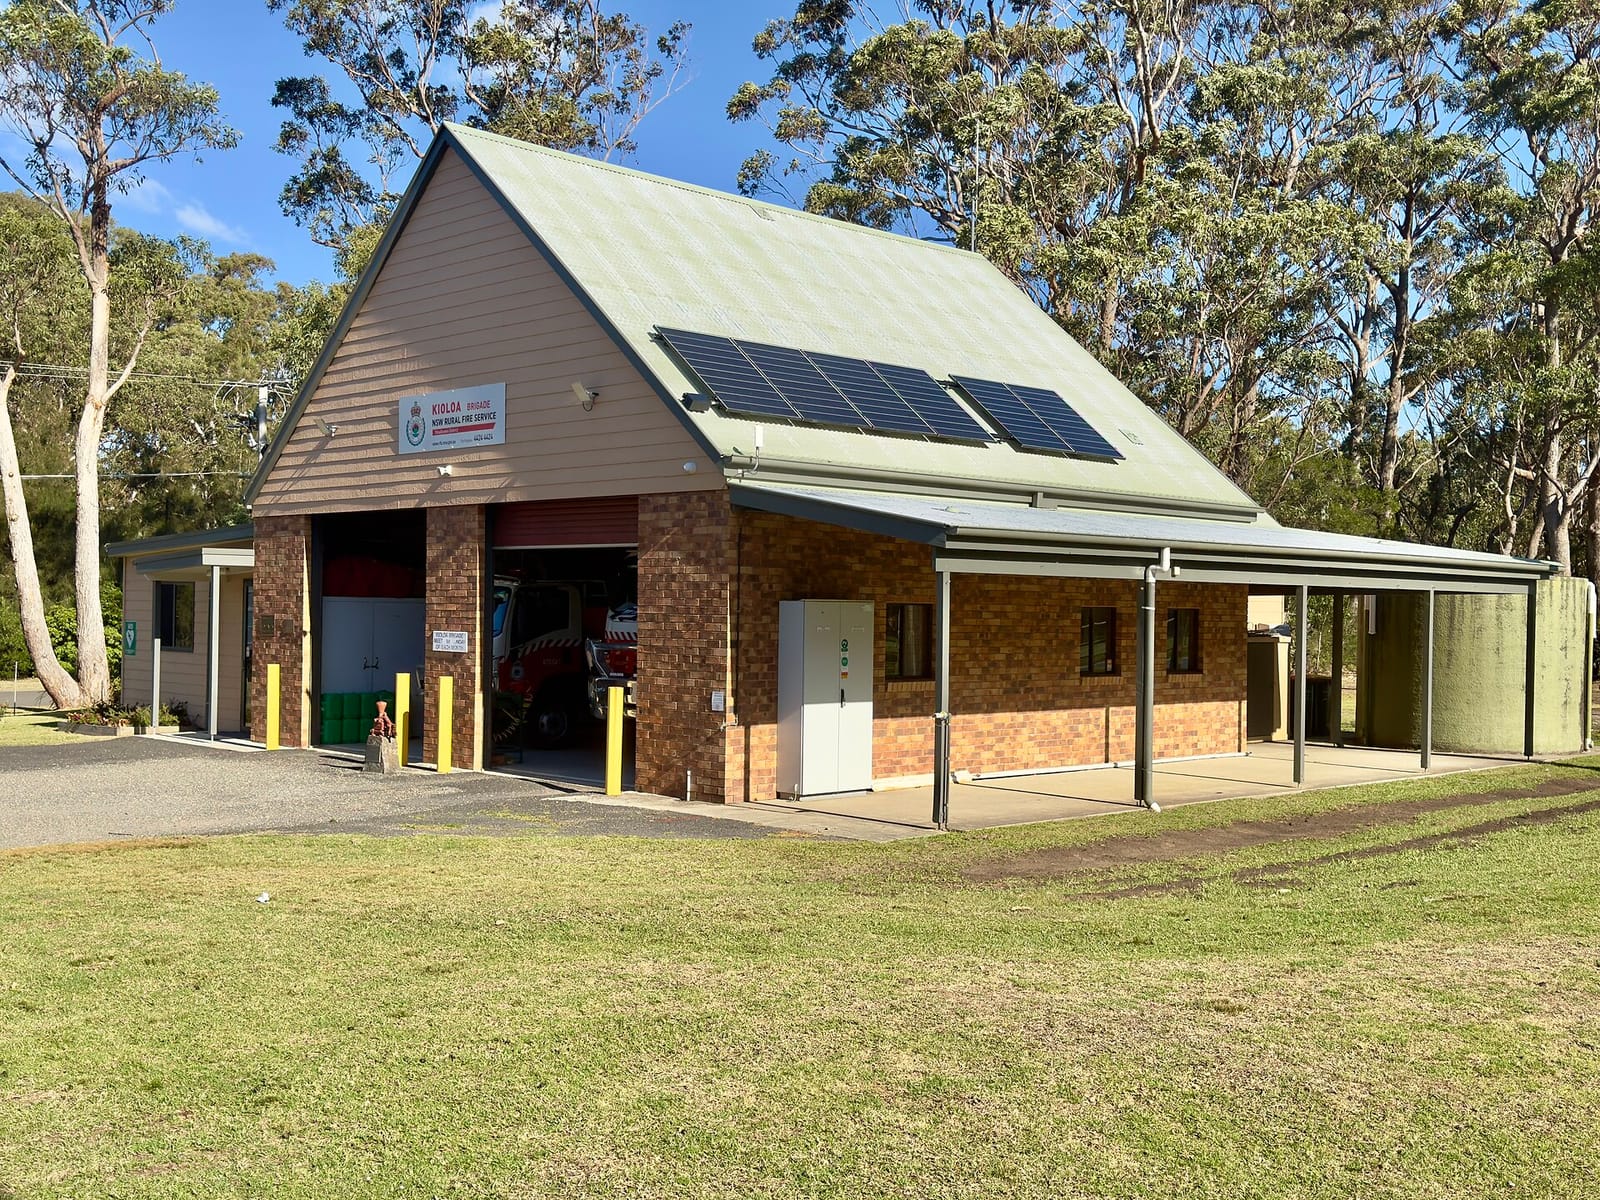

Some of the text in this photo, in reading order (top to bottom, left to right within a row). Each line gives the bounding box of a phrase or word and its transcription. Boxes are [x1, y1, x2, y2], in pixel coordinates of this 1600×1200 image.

[432, 400, 491, 415] KIOLOA BRIGADE
[432, 412, 496, 427] NSW RURAL FIRE SERVICE
